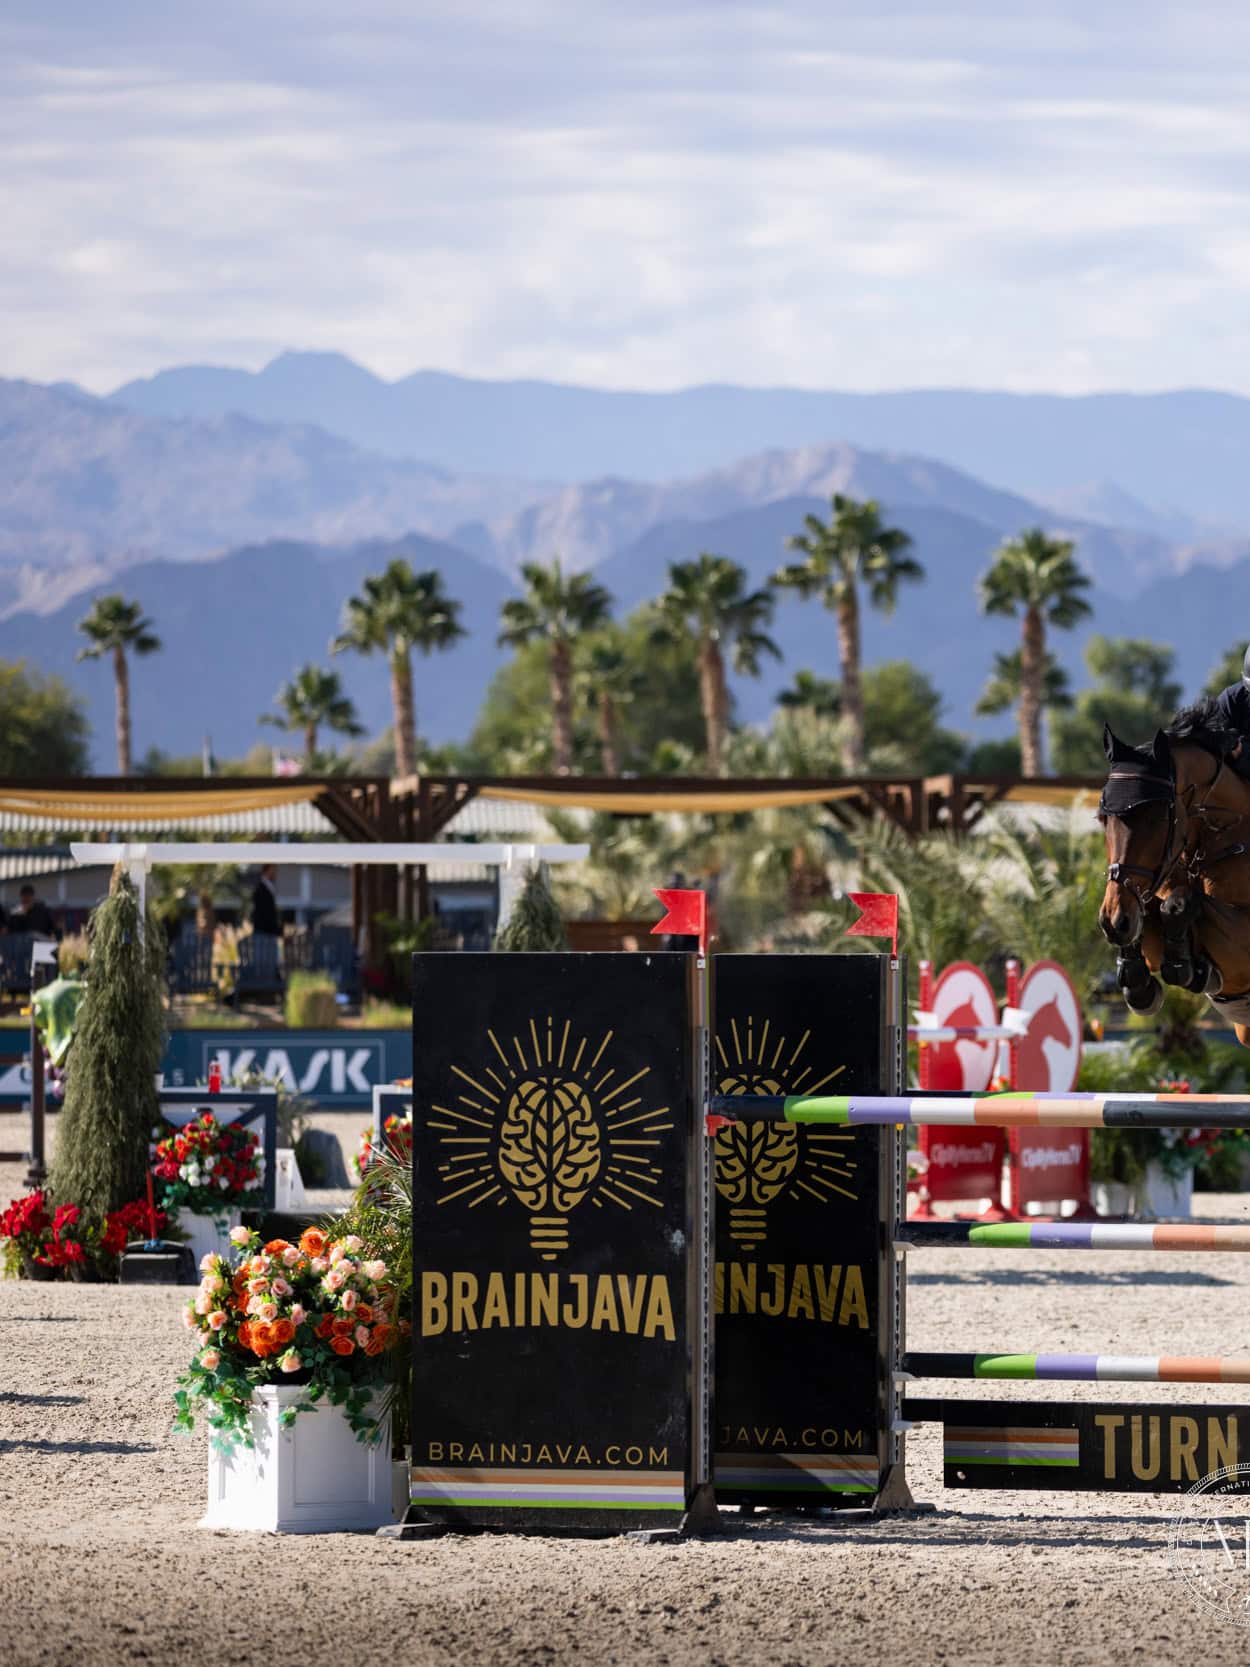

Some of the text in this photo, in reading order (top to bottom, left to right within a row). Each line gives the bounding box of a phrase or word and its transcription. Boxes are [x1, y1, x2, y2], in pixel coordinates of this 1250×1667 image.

[216, 1049, 371, 1093] KASK
[421, 1271, 676, 1342] BRAINJAVA
[428, 1441, 669, 1466] BRAINJAVA.COM
[1095, 1414, 1239, 1482] TURN
